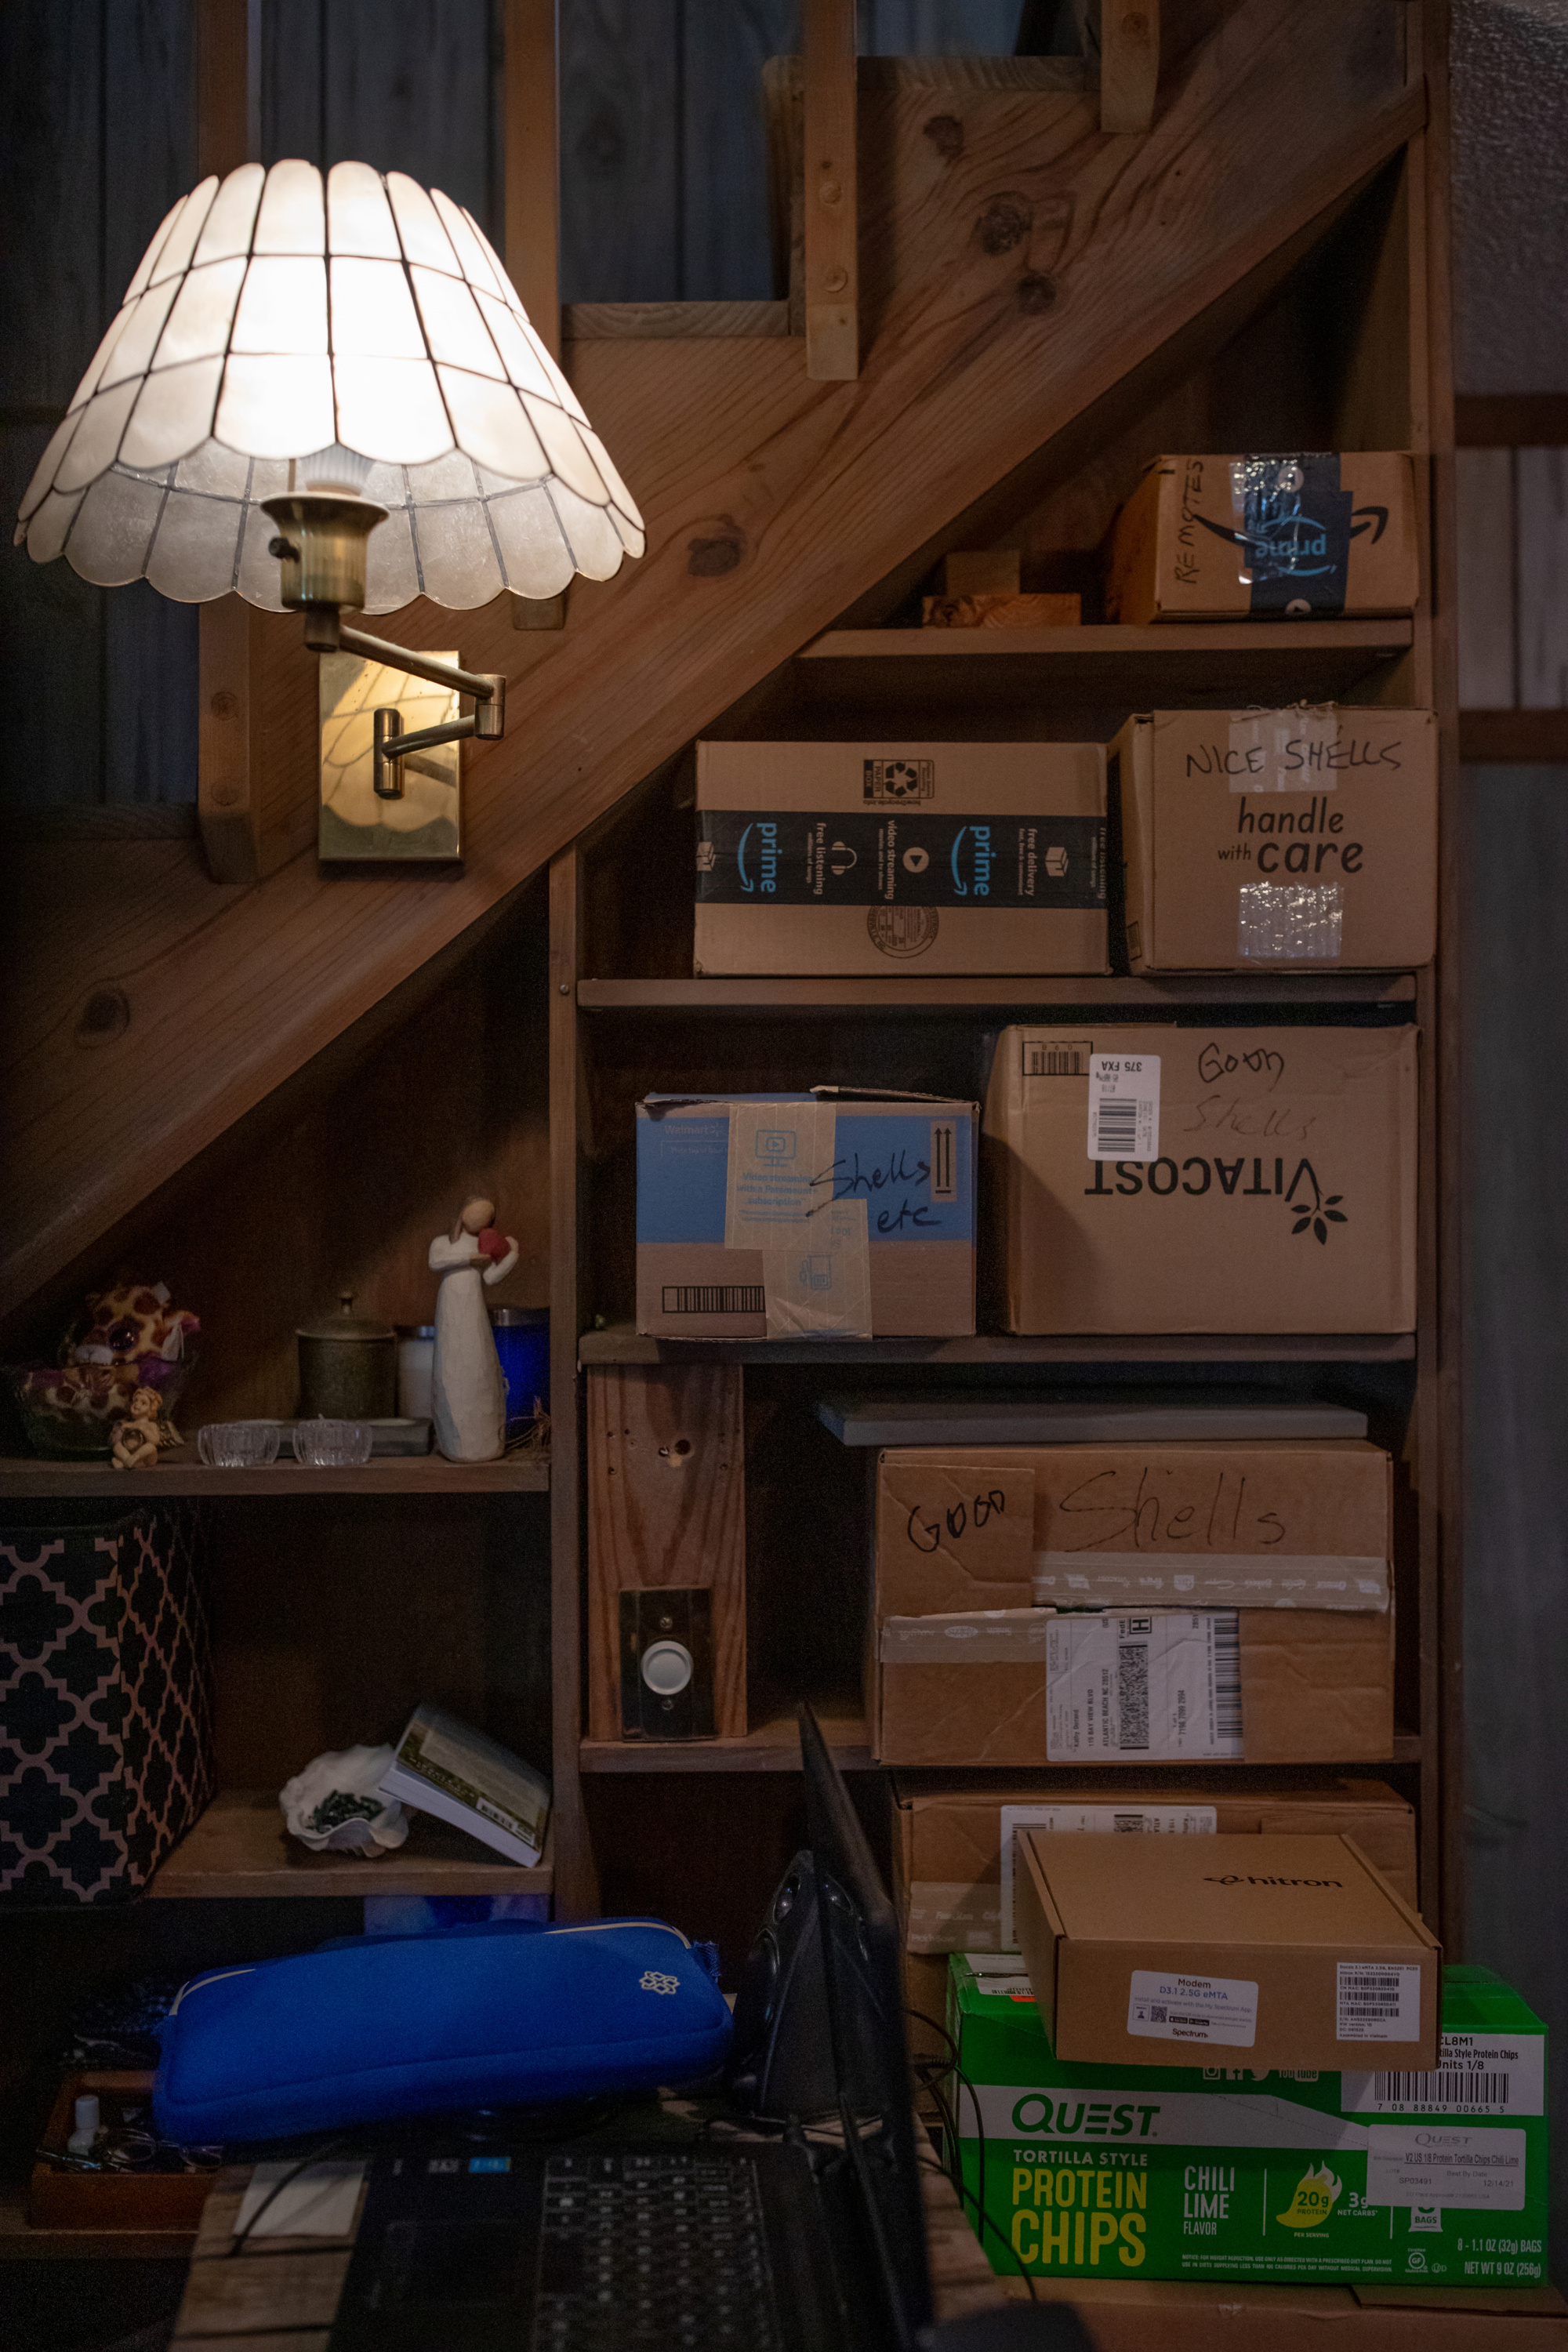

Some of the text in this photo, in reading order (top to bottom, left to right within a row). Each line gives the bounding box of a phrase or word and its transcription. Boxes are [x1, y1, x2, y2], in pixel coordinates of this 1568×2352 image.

[1174, 460, 1204, 584] REMOTES
[1186, 739, 1402, 777] NICE SHELLS
[1237, 797, 1345, 835] handle
[757, 822, 782, 892] prime
[812, 822, 827, 895] free listening
[884, 819, 898, 900] video streaming
[969, 826, 996, 897] prime
[1024, 828, 1038, 897] free delivery
[1217, 841, 1364, 874] with care
[1101, 1061, 1142, 1072] 375 FXA
[664, 1125, 709, 1134] Walmart
[742, 1172, 768, 1181] Video
[806, 1150, 931, 1218] Shells
[1084, 1157, 1321, 1206] VITACOST
[877, 1200, 942, 1233] etc
[1060, 1466, 1286, 1553] Shells
[1131, 1619, 1149, 1632] H
[1102, 1687, 1109, 1696] NC
[1248, 1875, 1344, 1889] hitron
[1178, 1978, 1211, 1989] Modem
[1160, 1986, 1229, 2000] D3.1 2.5G eMTA
[1214, 2004, 1240, 2013] Spectrum
[1172, 2028, 1207, 2038] Spectrum
[1454, 2049, 1472, 2060] Style
[1473, 2049, 1499, 2060] Protein
[1500, 2050, 1519, 2060] Chips
[1467, 2060, 1485, 2070] 1/8
[1011, 2092, 1160, 2137] QUEST
[1414, 2103, 1447, 2112] 88849
[1457, 2104, 1490, 2113] 00665
[1414, 2132, 1472, 2148] QUEST
[1013, 2150, 1149, 2167] TORTILLA STYLE
[1405, 2153, 1414, 2162] V2
[1414, 2153, 1423, 2162] US
[1424, 2154, 1432, 2162] 1/8
[1433, 2154, 1454, 2163] Protein
[1454, 2154, 1473, 2164] Tortilla
[1474, 2154, 1490, 2165] Chips
[1491, 2154, 1504, 2165] Chili
[1505, 2155, 1519, 2165] Lime
[1184, 2166, 1235, 2192] CHILI
[1012, 2169, 1147, 2210] PROTEIN
[1184, 2193, 1229, 2220] LIME
[1298, 2191, 1330, 2208] 20g
[1184, 2220, 1218, 2236] FLAVOR
[1011, 2210, 1147, 2268] CHIPS
[1457, 2238, 1463, 2252] 8
[1472, 2239, 1483, 2252] 1.1
[1486, 2239, 1497, 2252] OZ
[1498, 2240, 1519, 2255] (32g)
[1520, 2240, 1542, 2253] BAGS
[1465, 2261, 1541, 2278] NET WT 9 OZ (256g)
